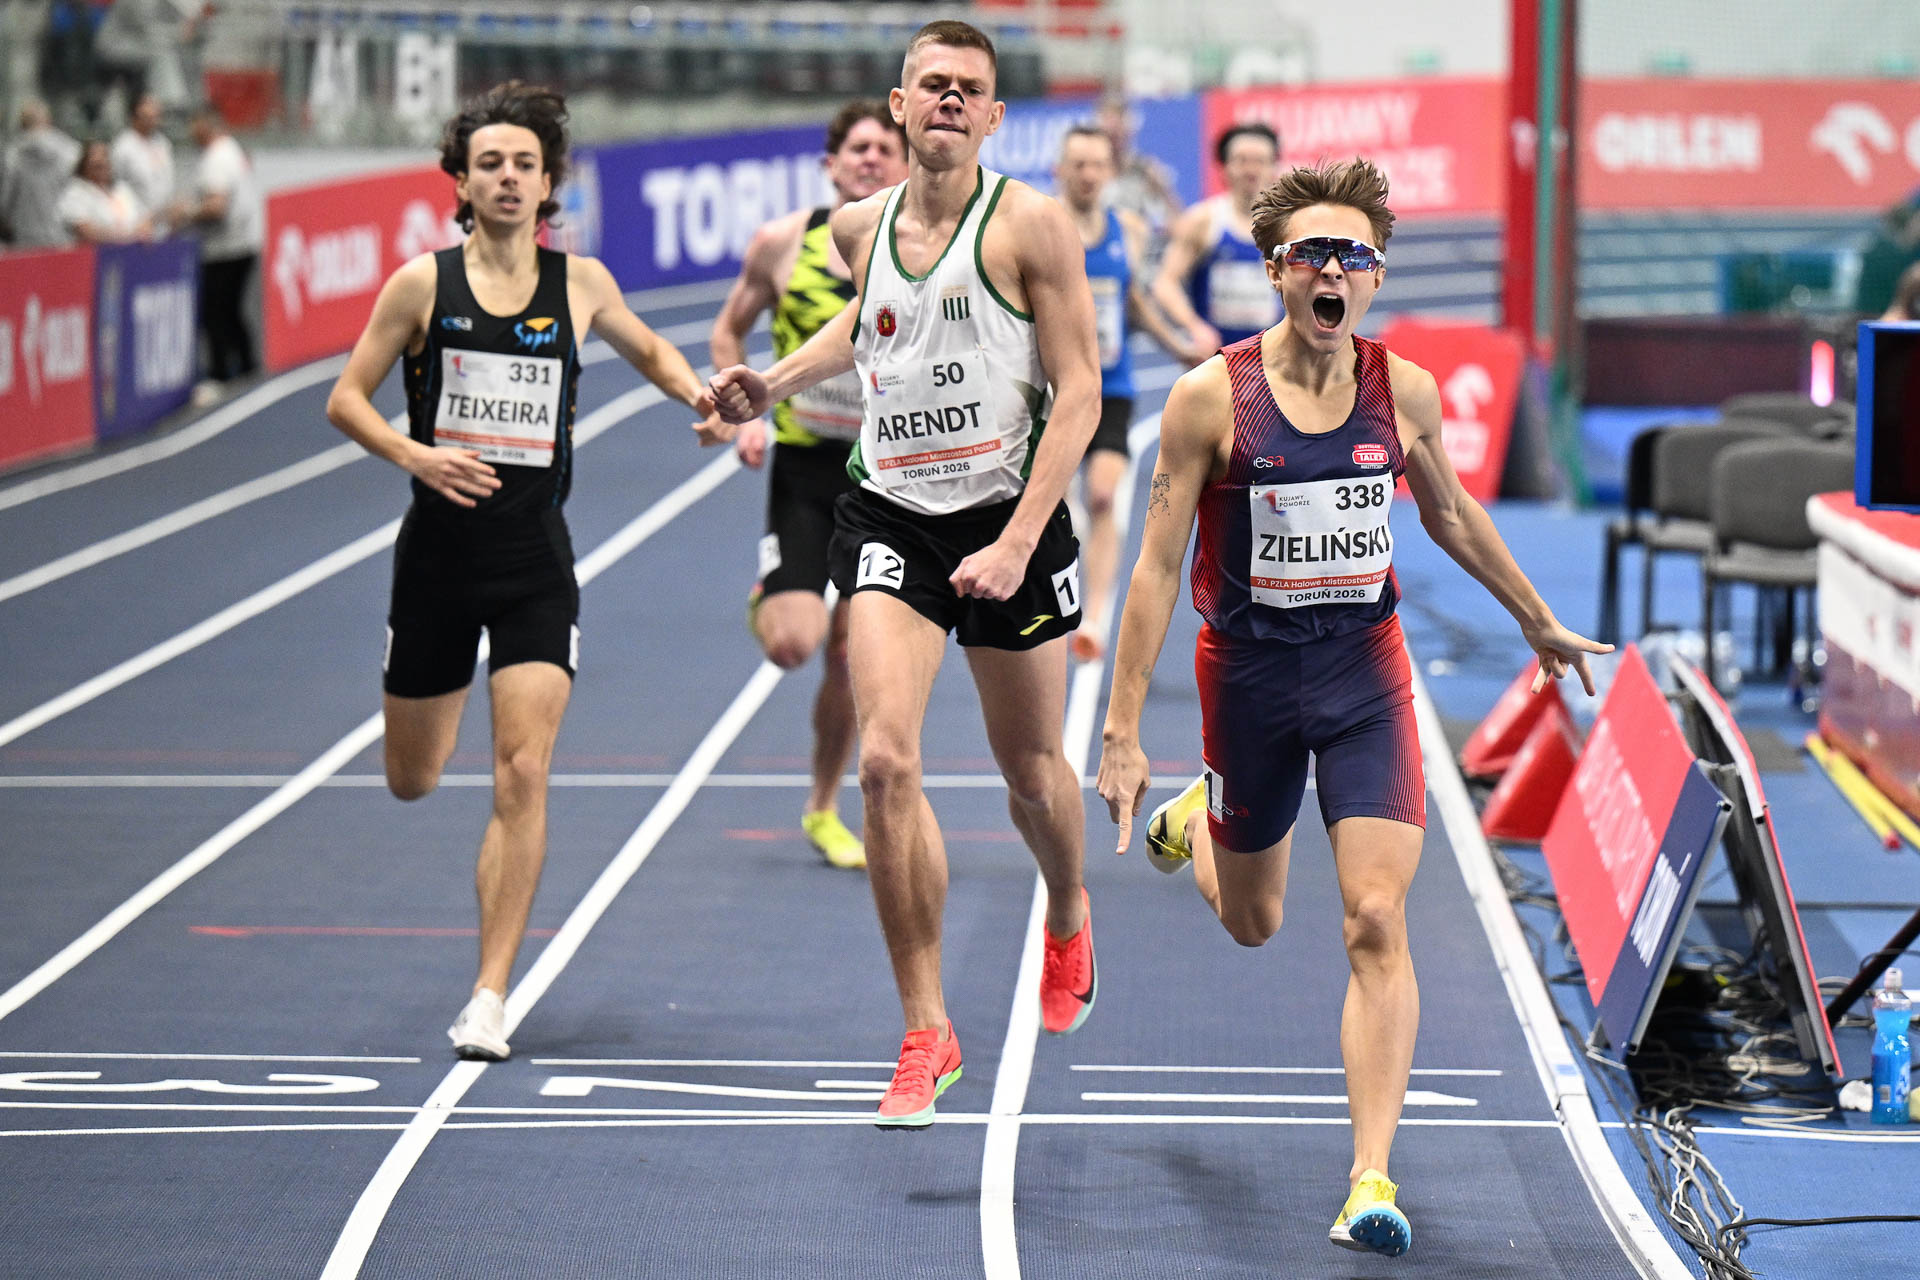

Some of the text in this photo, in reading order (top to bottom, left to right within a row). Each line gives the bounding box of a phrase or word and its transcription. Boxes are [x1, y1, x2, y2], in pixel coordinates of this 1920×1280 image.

[509, 362, 551, 385] 331
[932, 361, 965, 388] 50
[447, 392, 550, 425] TEIXEIRA
[876, 401, 981, 443] ARENDT
[902, 455, 929, 465] Halowe
[929, 449, 973, 461] Mistrzostwa
[973, 441, 997, 454] Polski
[1253, 455, 1286, 469] esa
[1356, 452, 1385, 462] TALEX
[902, 464, 940, 480] TORUŃ
[942, 461, 971, 474] 2026
[1278, 500, 1311, 508] POMORZE
[1279, 494, 1305, 502] KUJAWY
[1335, 482, 1385, 511] 338
[1258, 525, 1391, 563] ZIELIŃSKI
[861, 550, 903, 582] 12
[1057, 564, 1080, 606] 1
[1270, 580, 1290, 589] PZLA
[1291, 578, 1322, 589] Halowe
[1322, 576, 1372, 586] Mistrzostwa
[1372, 569, 1389, 581] Pol
[1286, 588, 1366, 603] TORUŃ 2026
